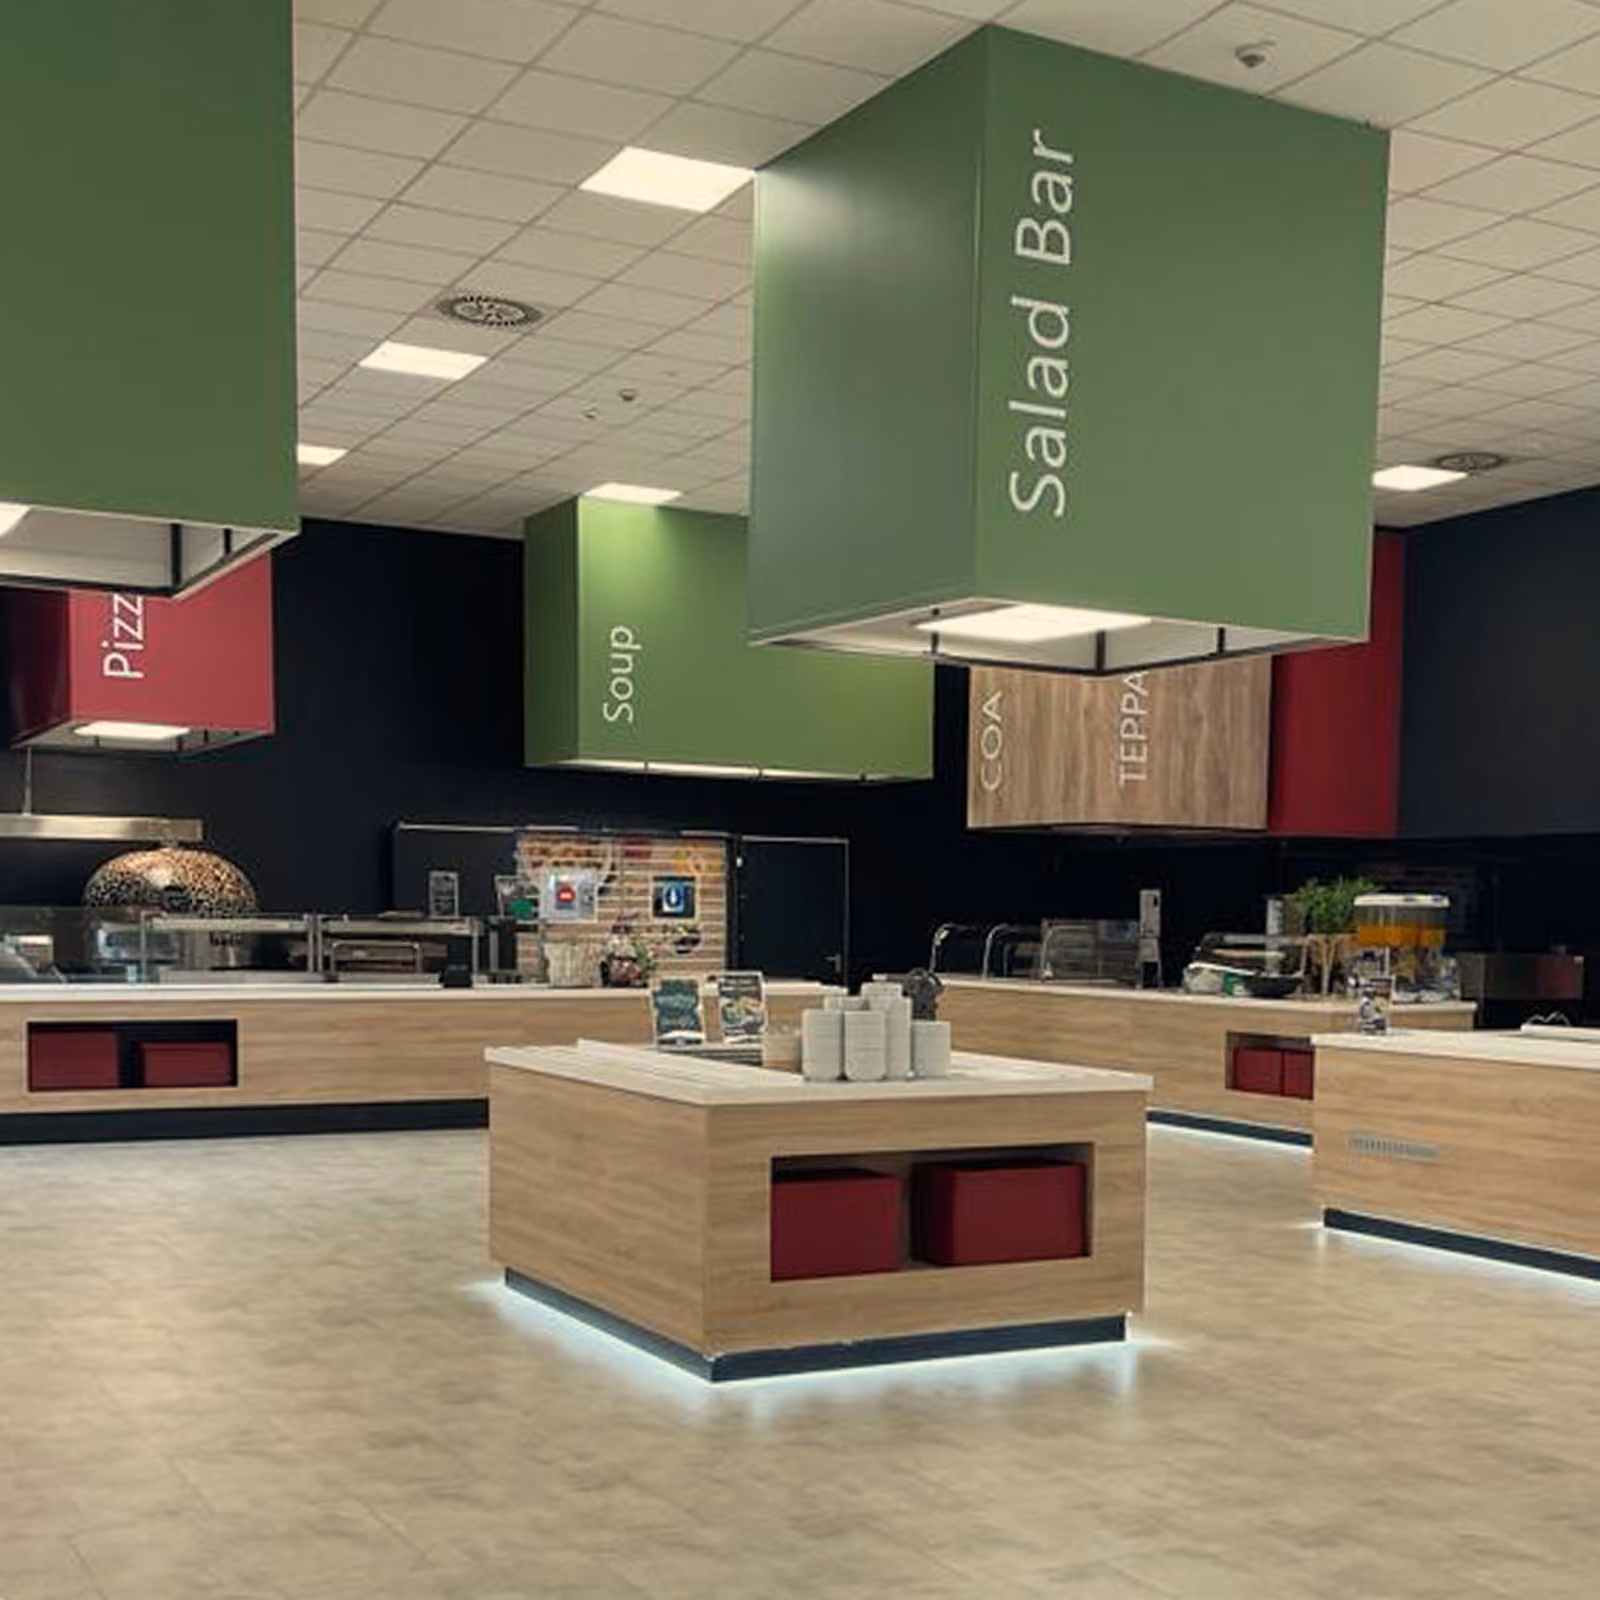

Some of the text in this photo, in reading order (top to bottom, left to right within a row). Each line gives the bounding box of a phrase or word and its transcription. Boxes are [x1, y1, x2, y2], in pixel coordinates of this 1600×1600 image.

[1008, 128, 1075, 518] Salad Bar
[101, 593, 144, 678] Pizz
[602, 625, 641, 723] Soup
[980, 691, 1002, 791] COA
[1120, 670, 1149, 788] TEPPA
